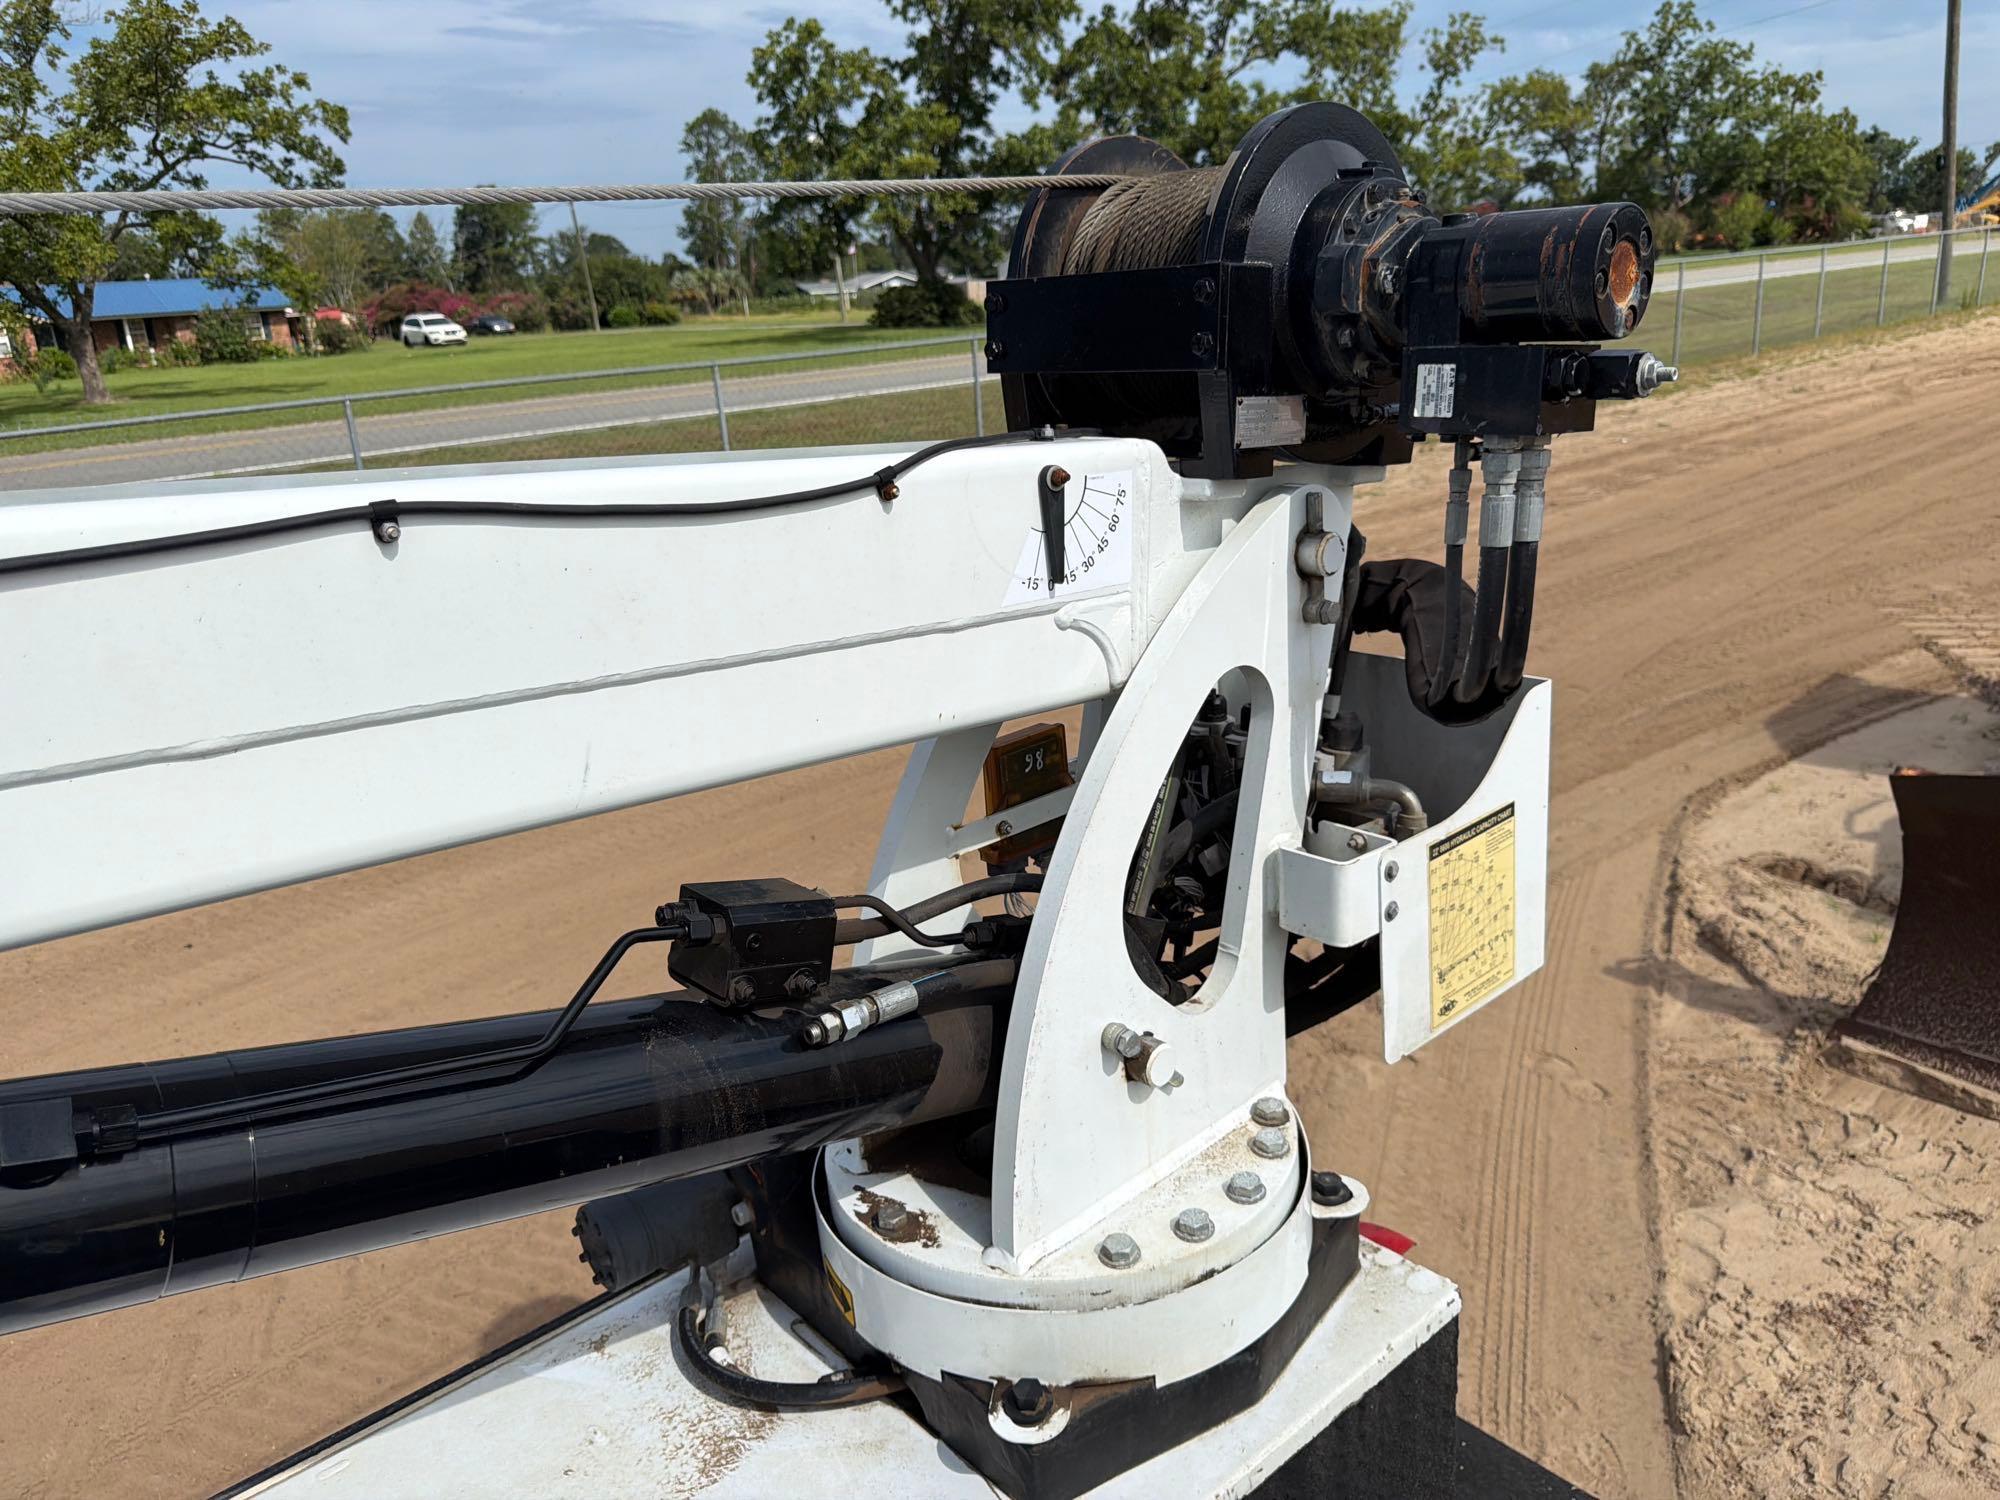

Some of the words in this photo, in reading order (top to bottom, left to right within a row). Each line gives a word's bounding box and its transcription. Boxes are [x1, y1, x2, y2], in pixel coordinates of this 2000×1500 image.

[1450, 827, 1476, 848] HYDRAULIC
[1476, 817, 1498, 833] CAPACITY
[1497, 807, 1512, 822] CHART
